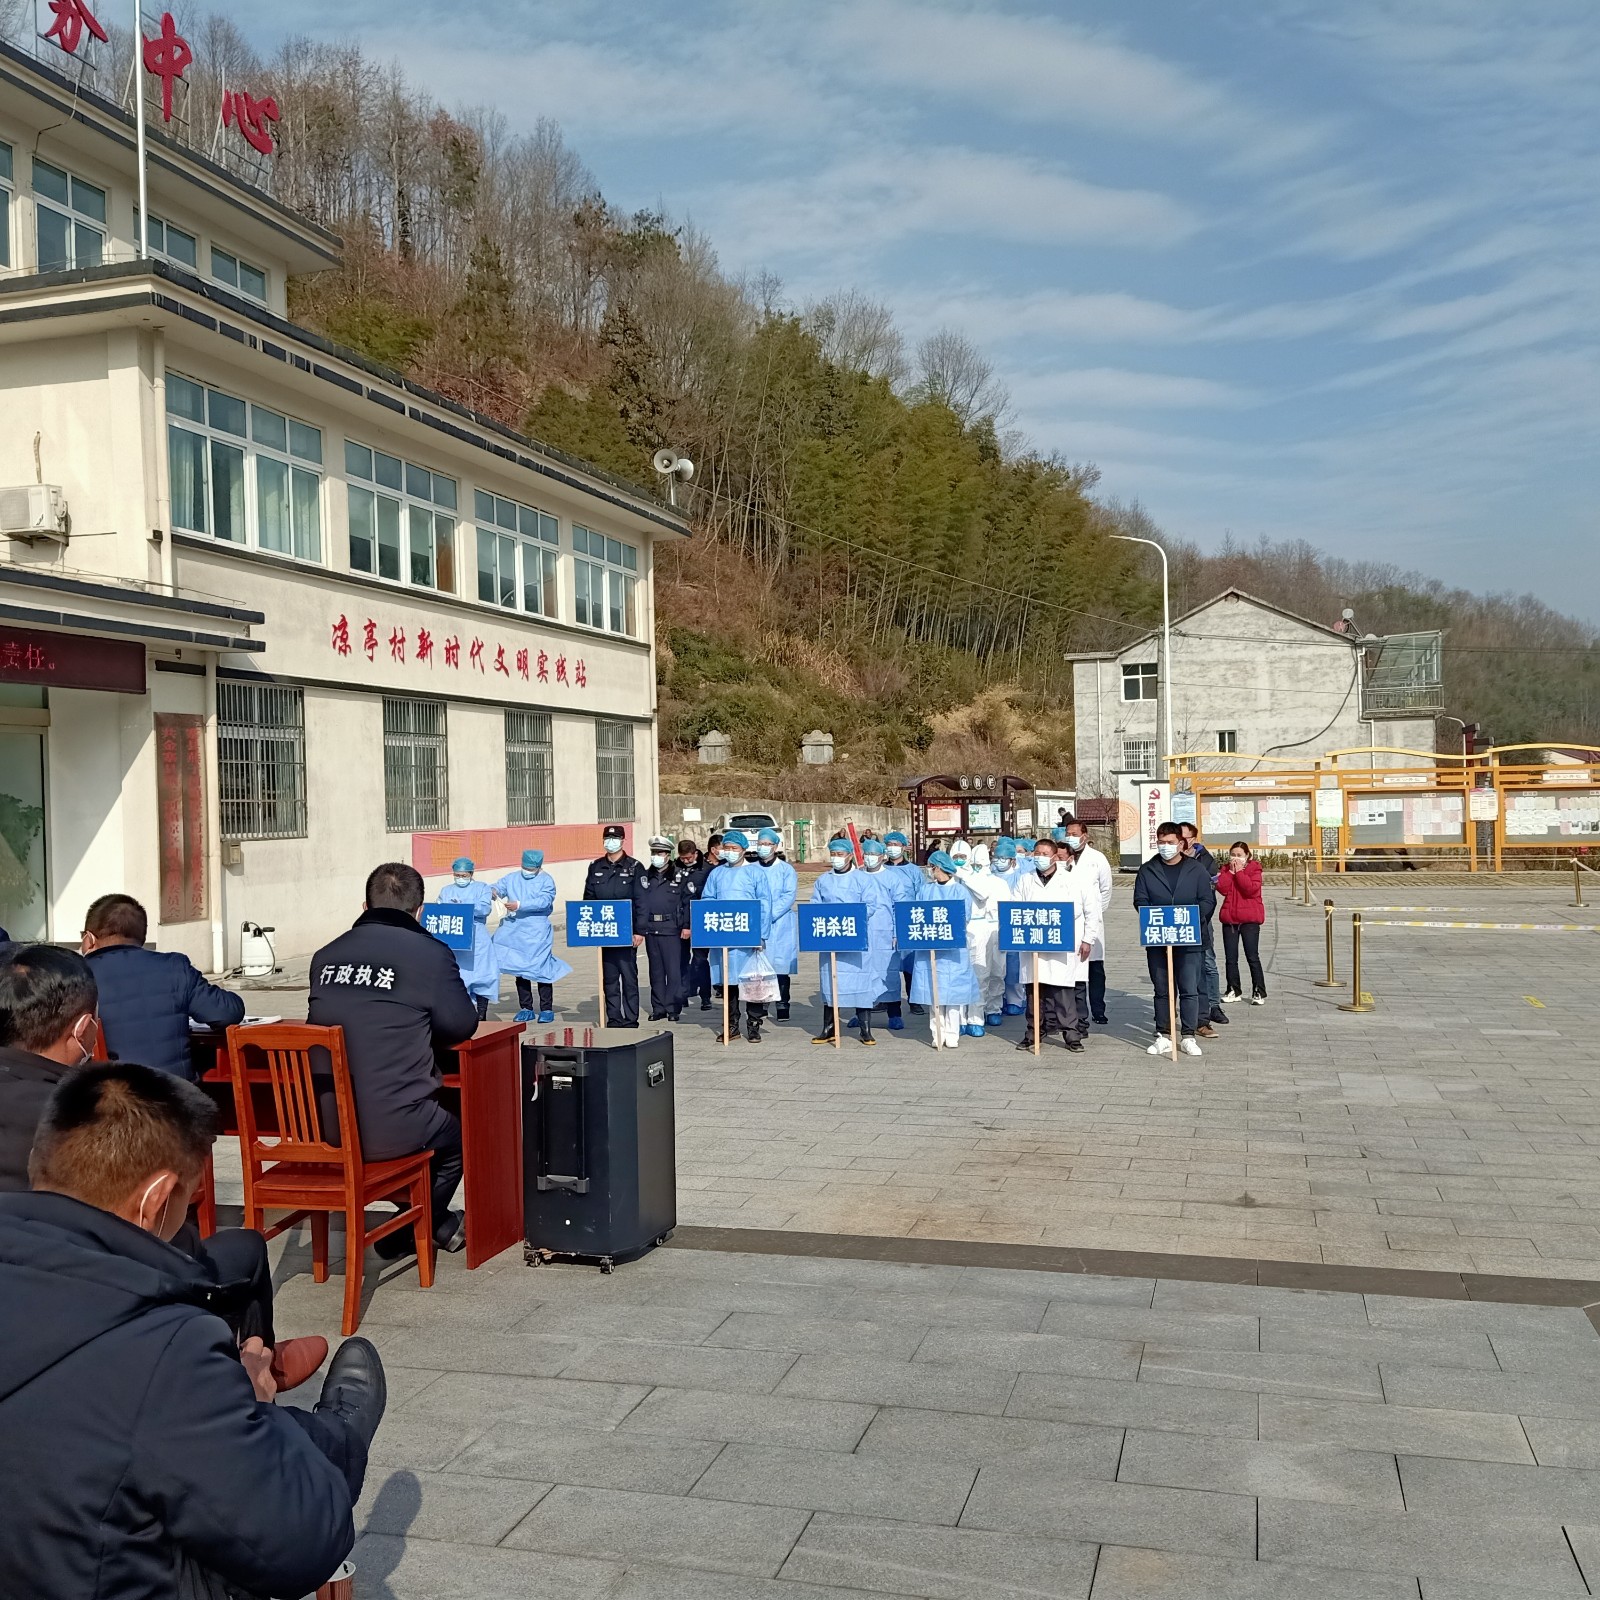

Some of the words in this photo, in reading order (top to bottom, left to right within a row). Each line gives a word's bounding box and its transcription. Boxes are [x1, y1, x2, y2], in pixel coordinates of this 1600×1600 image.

[332, 614, 587, 688] 凉亭村新时代文明实践站
[579, 905, 615, 921] 安保
[704, 912, 749, 932] 转运组
[910, 906, 949, 922] 核酸
[1010, 908, 1061, 926] 居家健康
[1148, 907, 1190, 925] 后勤
[426, 915, 464, 935] 流调组
[576, 921, 619, 938] 管控组
[812, 916, 857, 937] 消杀组
[908, 923, 954, 941] 采样组
[1011, 927, 1062, 945] 监测组
[1144, 926, 1196, 944] 保障组
[319, 963, 395, 990] 行政执法
